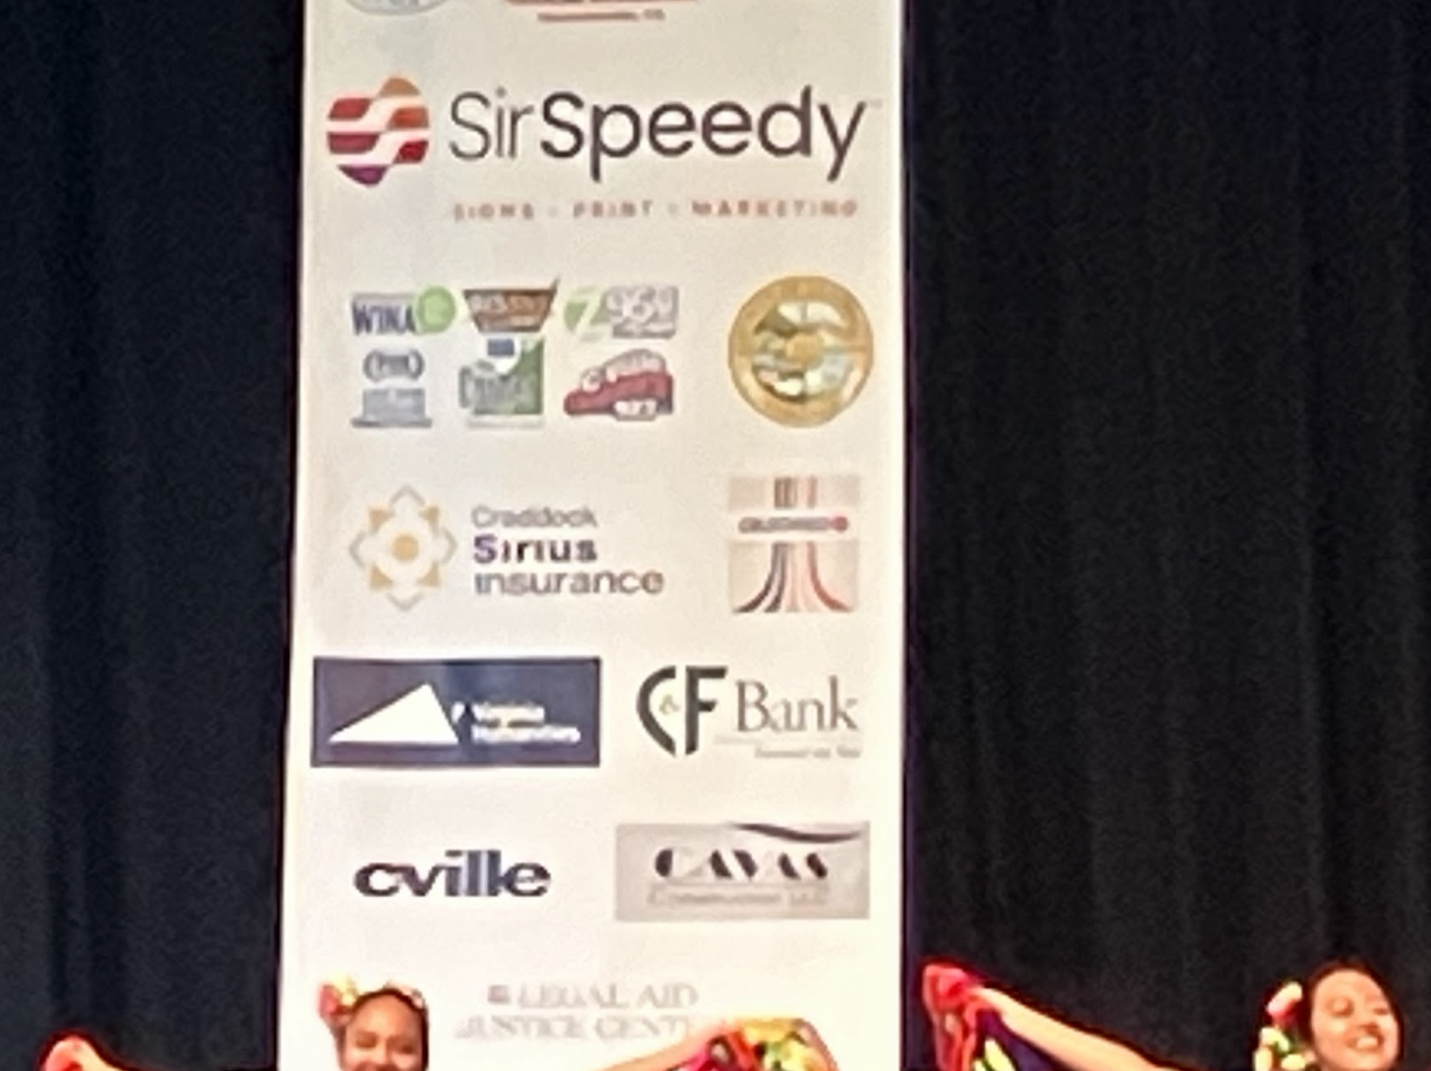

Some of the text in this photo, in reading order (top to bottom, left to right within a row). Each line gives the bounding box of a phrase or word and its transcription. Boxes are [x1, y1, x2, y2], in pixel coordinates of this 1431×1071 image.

[572, 200, 653, 219] PRINT
[691, 198, 858, 218] MARKETING
[473, 533, 598, 564] Sirius
[735, 675, 859, 733] Bank
[353, 849, 552, 898] cville
[517, 983, 699, 1009] LEGAL AID
